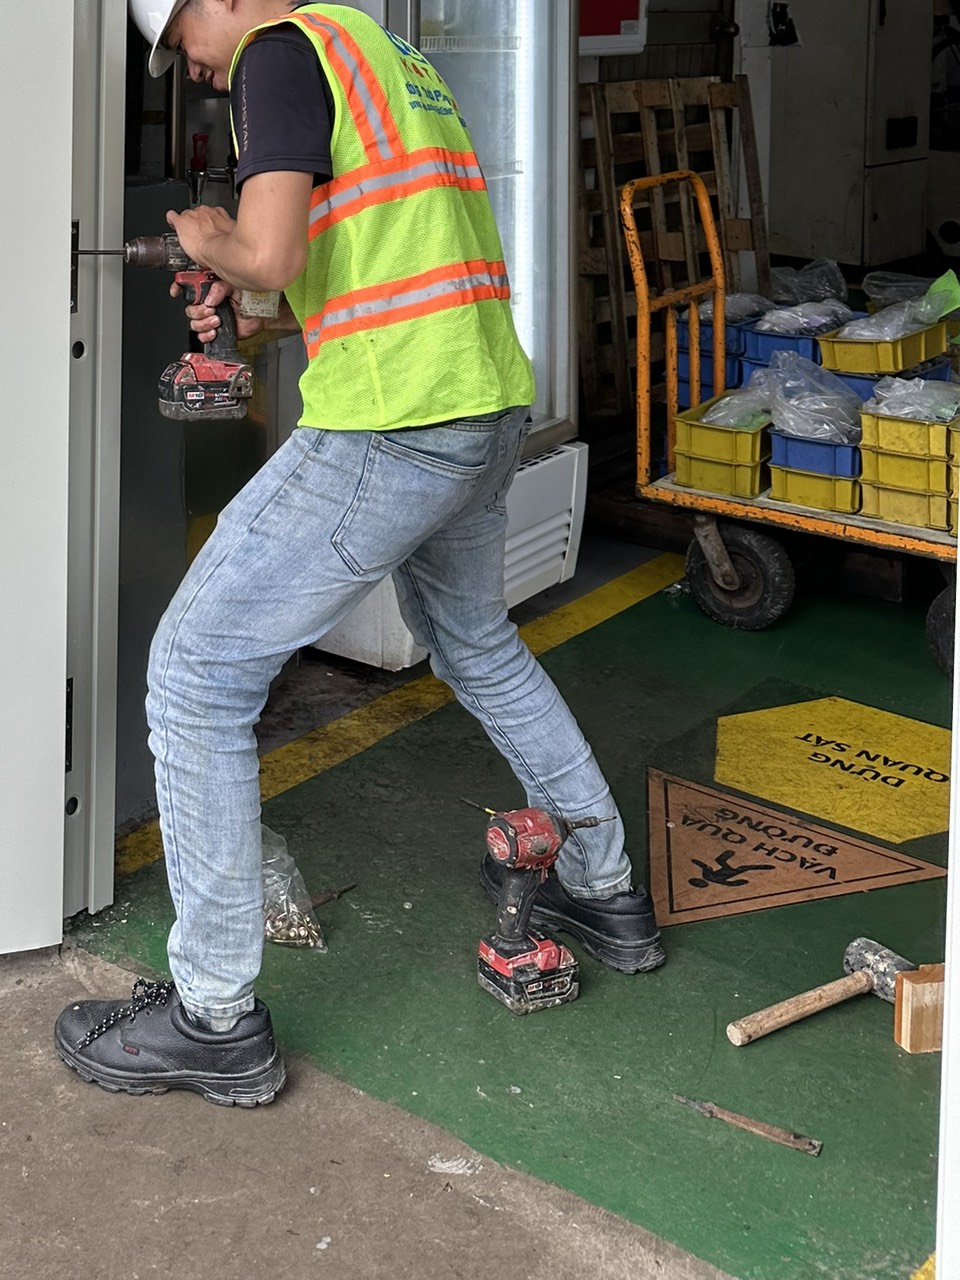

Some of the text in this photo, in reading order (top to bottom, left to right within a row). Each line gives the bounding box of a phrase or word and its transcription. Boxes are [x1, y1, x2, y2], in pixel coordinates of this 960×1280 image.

[794, 732, 950, 783] QUAN SÁT
[807, 752, 906, 788] DỪNG
[681, 814, 837, 880] VẠCH QUA
[714, 808, 838, 857] ĐƯỜNG
